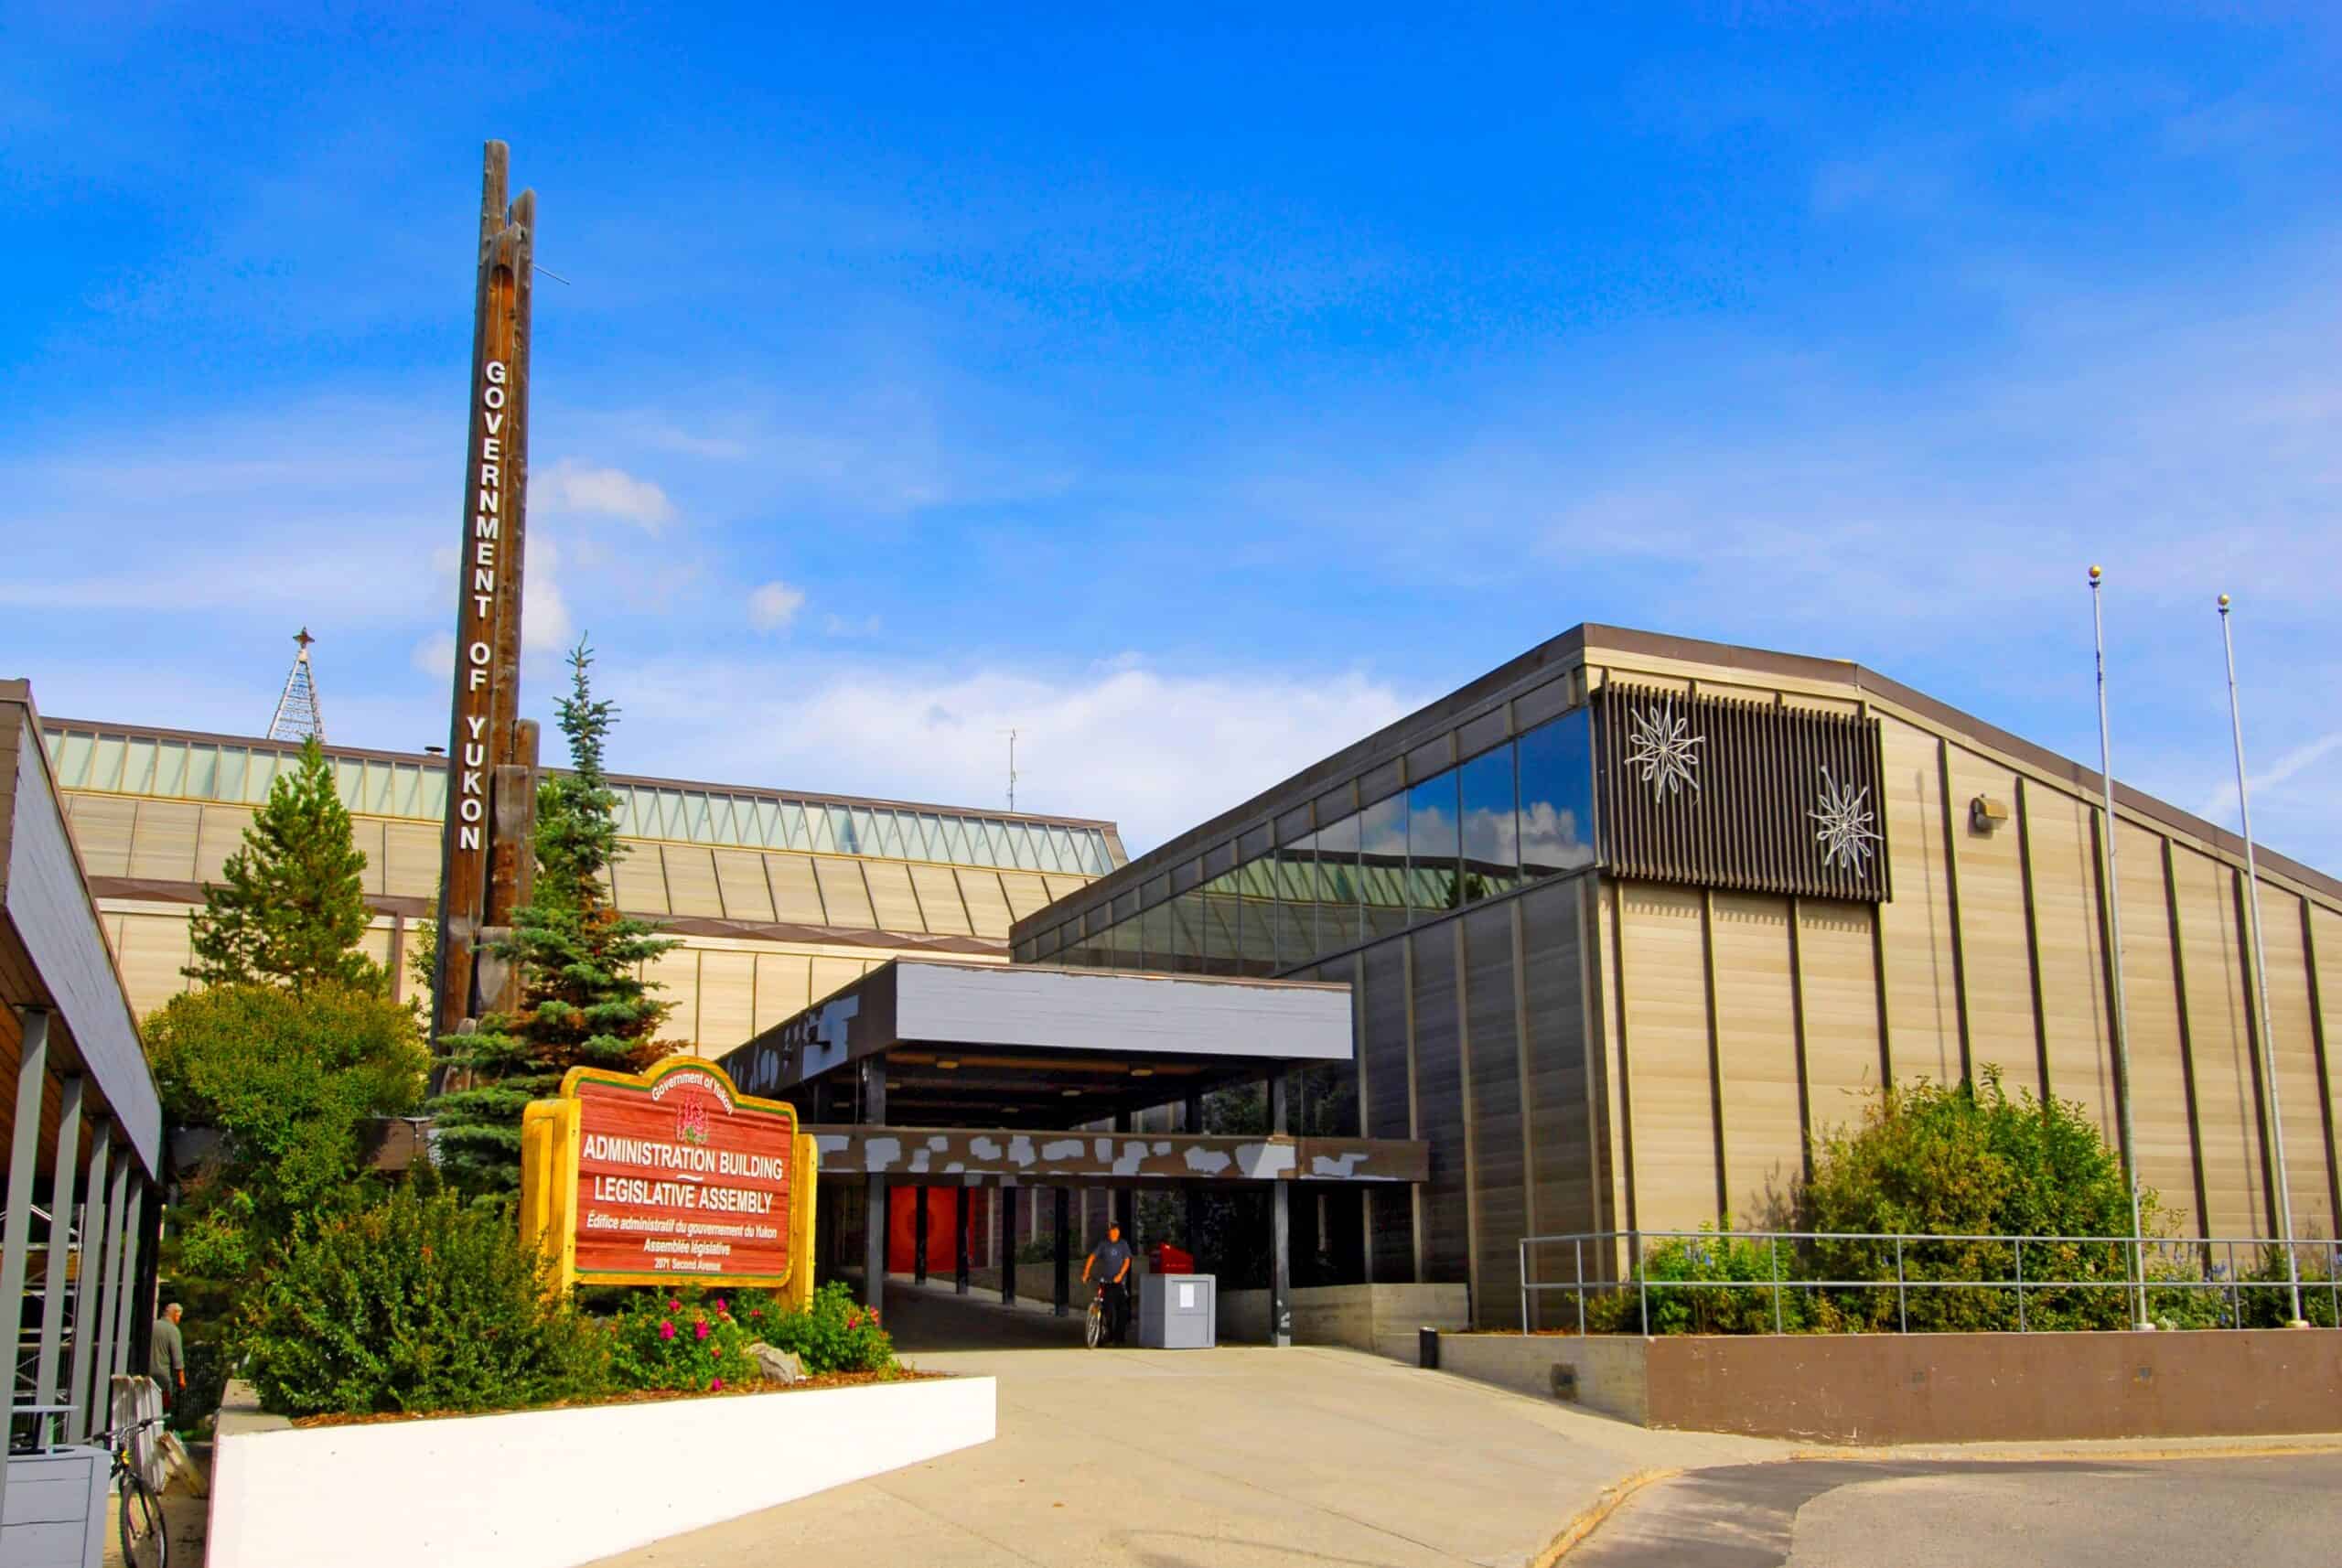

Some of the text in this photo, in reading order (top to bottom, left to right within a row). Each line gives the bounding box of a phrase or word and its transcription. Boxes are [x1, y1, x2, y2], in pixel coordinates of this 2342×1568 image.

[460, 361, 506, 850] GOVERNMENT OF YUKON
[651, 1070, 733, 1115] Government of Yukon
[583, 1134, 783, 1180] ADMINISTRATION BUILDING
[595, 1176, 774, 1214] LEGISLATIVE ASSEMBLY
[586, 1209, 778, 1239] Édifice administratif du gouvernement du Yukon
[643, 1238, 731, 1257] Assemblée législative
